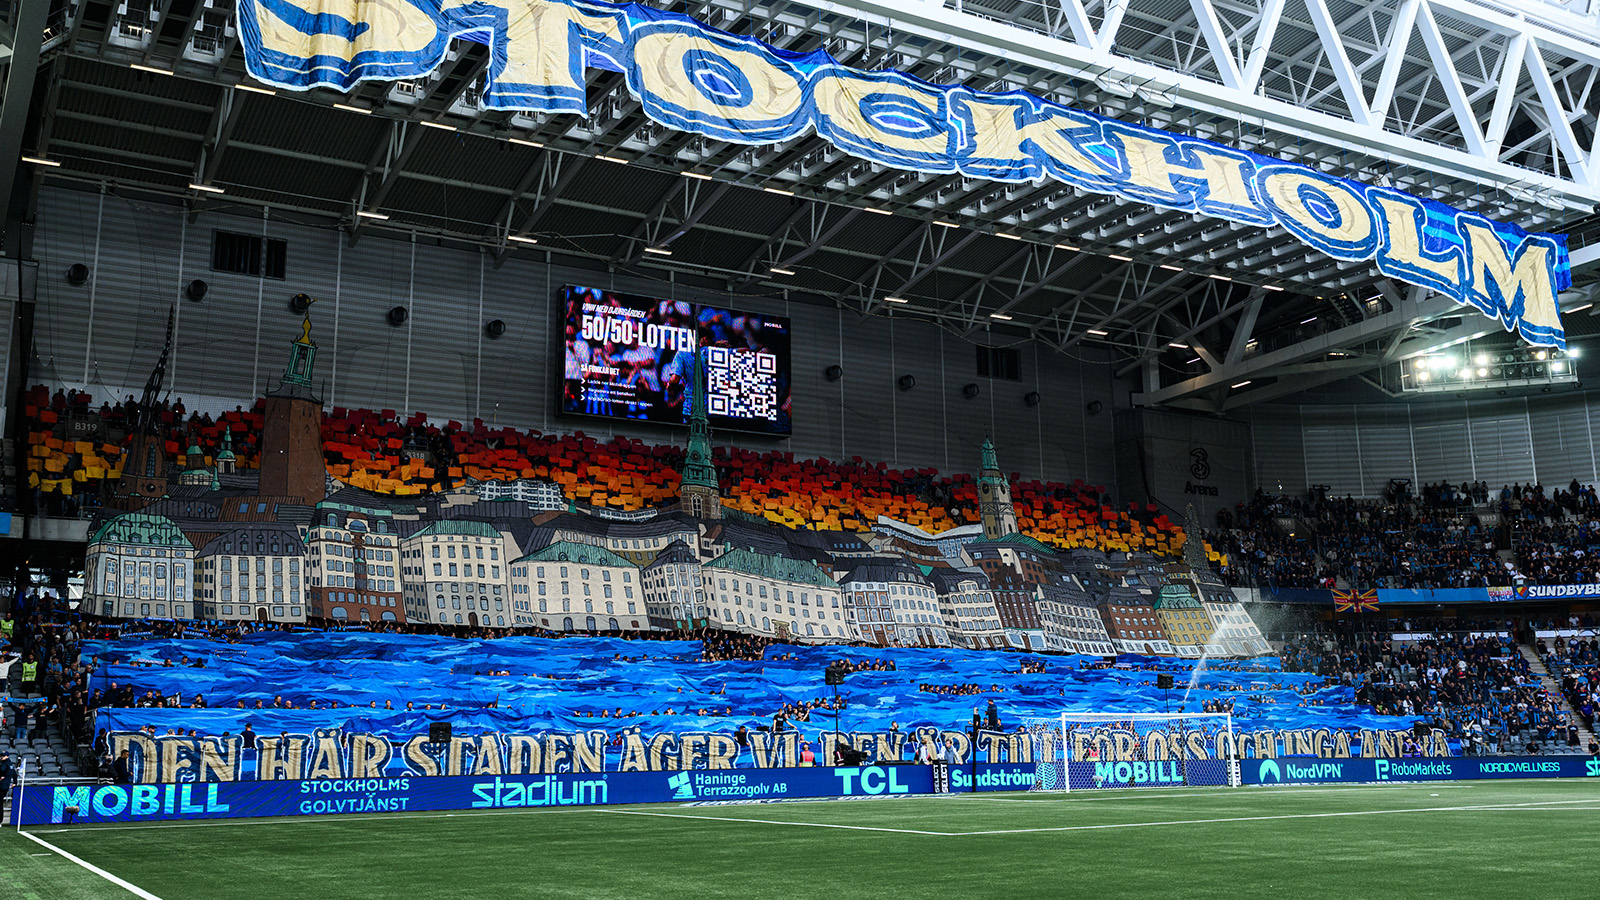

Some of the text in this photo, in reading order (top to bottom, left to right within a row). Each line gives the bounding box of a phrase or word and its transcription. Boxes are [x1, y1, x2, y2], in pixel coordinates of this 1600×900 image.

[236, 0, 1565, 350] STOCKHOLM
[582, 314, 696, 353] 50/50-LOTTEN
[75, 422, 97, 431] B319
[1184, 481, 1219, 496] Arena
[107, 731, 243, 784] DEN
[254, 728, 394, 781] HÄR
[402, 731, 607, 777] STADEN
[619, 725, 740, 772] ÄGER
[1280, 728, 1351, 759] INGA
[1095, 761, 1184, 788] MOBILL
[1286, 763, 1343, 779] NordVPN
[1391, 761, 1453, 776] RoboMarkets
[1479, 762, 1561, 773] NORDICWELLNESS
[1585, 756, 1600, 776] st
[300, 778, 410, 795] STOCKHOLMS
[695, 773, 746, 787] Haninge
[834, 766, 909, 795] TCL
[940, 764, 949, 793] SELECT
[951, 768, 1036, 788] Sundström
[472, 776, 607, 808] stadium
[696, 782, 788, 798] Terrazzogolv AB
[52, 783, 229, 823] MOBILL
[300, 792, 409, 814] GOLVTJÄNST
